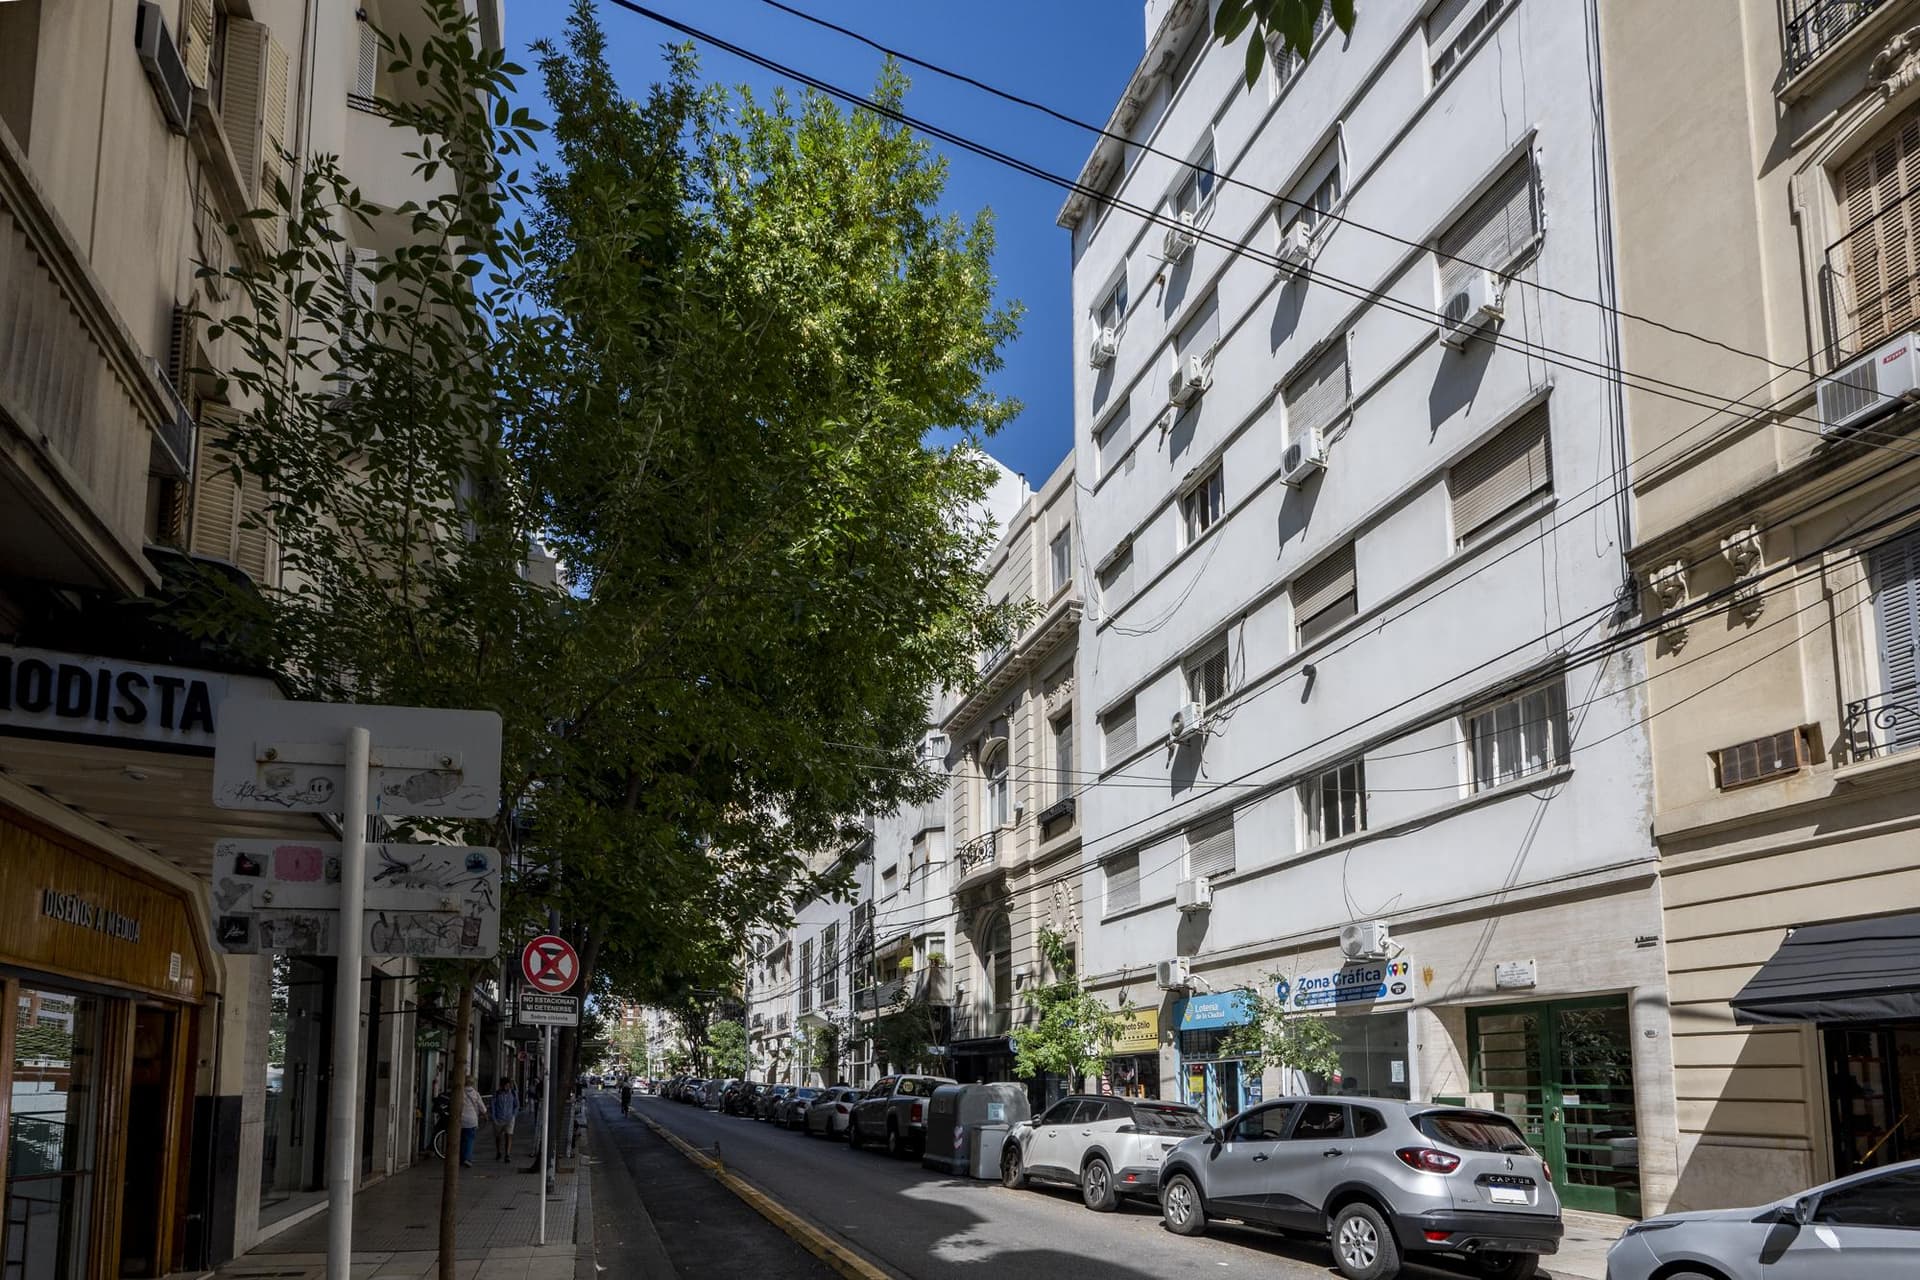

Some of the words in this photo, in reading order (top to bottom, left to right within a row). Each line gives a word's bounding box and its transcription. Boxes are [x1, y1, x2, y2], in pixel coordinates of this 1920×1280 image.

[0, 656, 215, 733] ODISTA
[44, 888, 93, 928] DISEÑOS
[95, 908, 105, 932] A
[105, 911, 141, 944] MEDIDA
[1298, 976, 1329, 991] Zona
[1333, 967, 1381, 986] Gráfica
[535, 997, 575, 1005] ESTACIONAR
[535, 1004, 572, 1013] DETENERSE
[1489, 1176, 1530, 1185] CAPTUR
